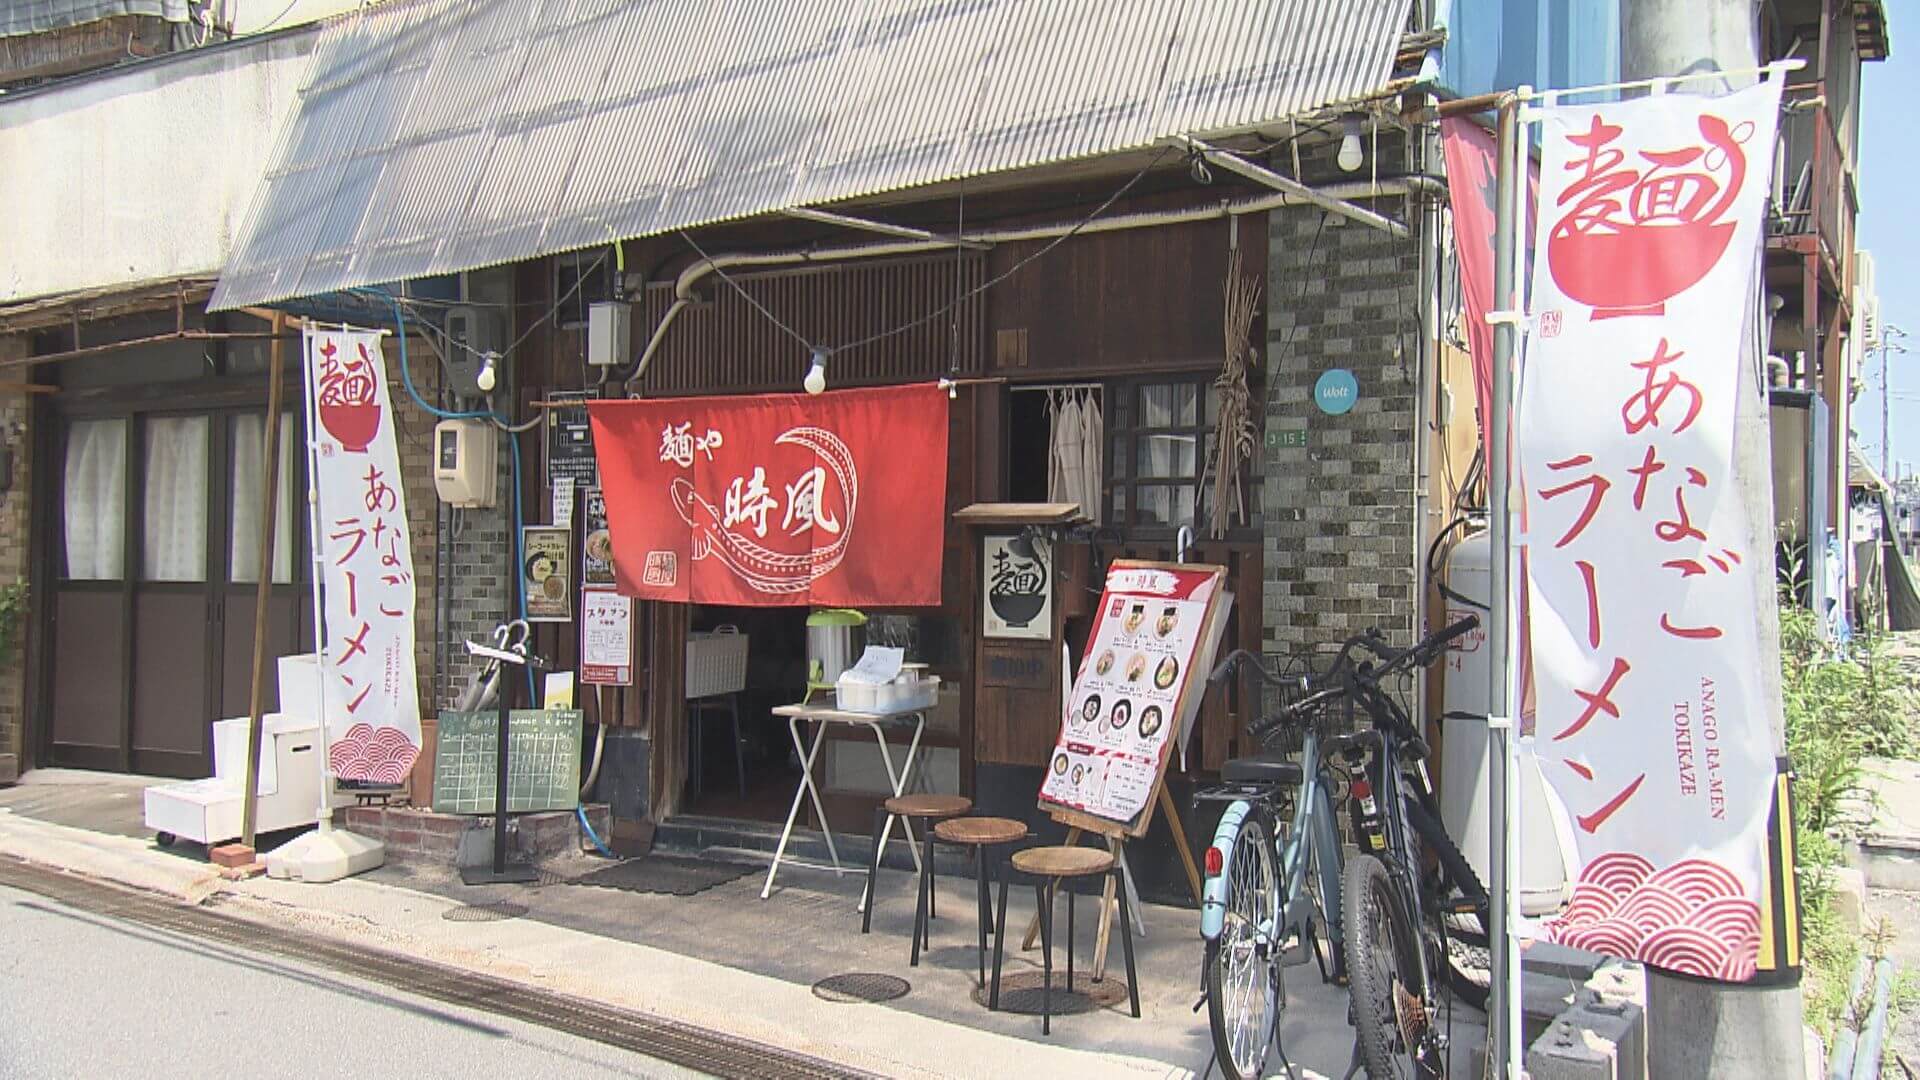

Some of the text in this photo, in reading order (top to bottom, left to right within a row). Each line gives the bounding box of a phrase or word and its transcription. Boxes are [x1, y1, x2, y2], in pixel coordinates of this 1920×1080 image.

[1323, 386, 1349, 398] Wolt
[362, 464, 411, 618] あなご
[723, 465, 841, 538] 時風
[1621, 336, 1742, 640] あなご
[330, 517, 372, 714] ラーメン
[1536, 454, 1647, 834] ラーメン
[1673, 701, 1697, 797] TOKIKAZE
[1699, 677, 1726, 821] ANAGO RA-MEN
